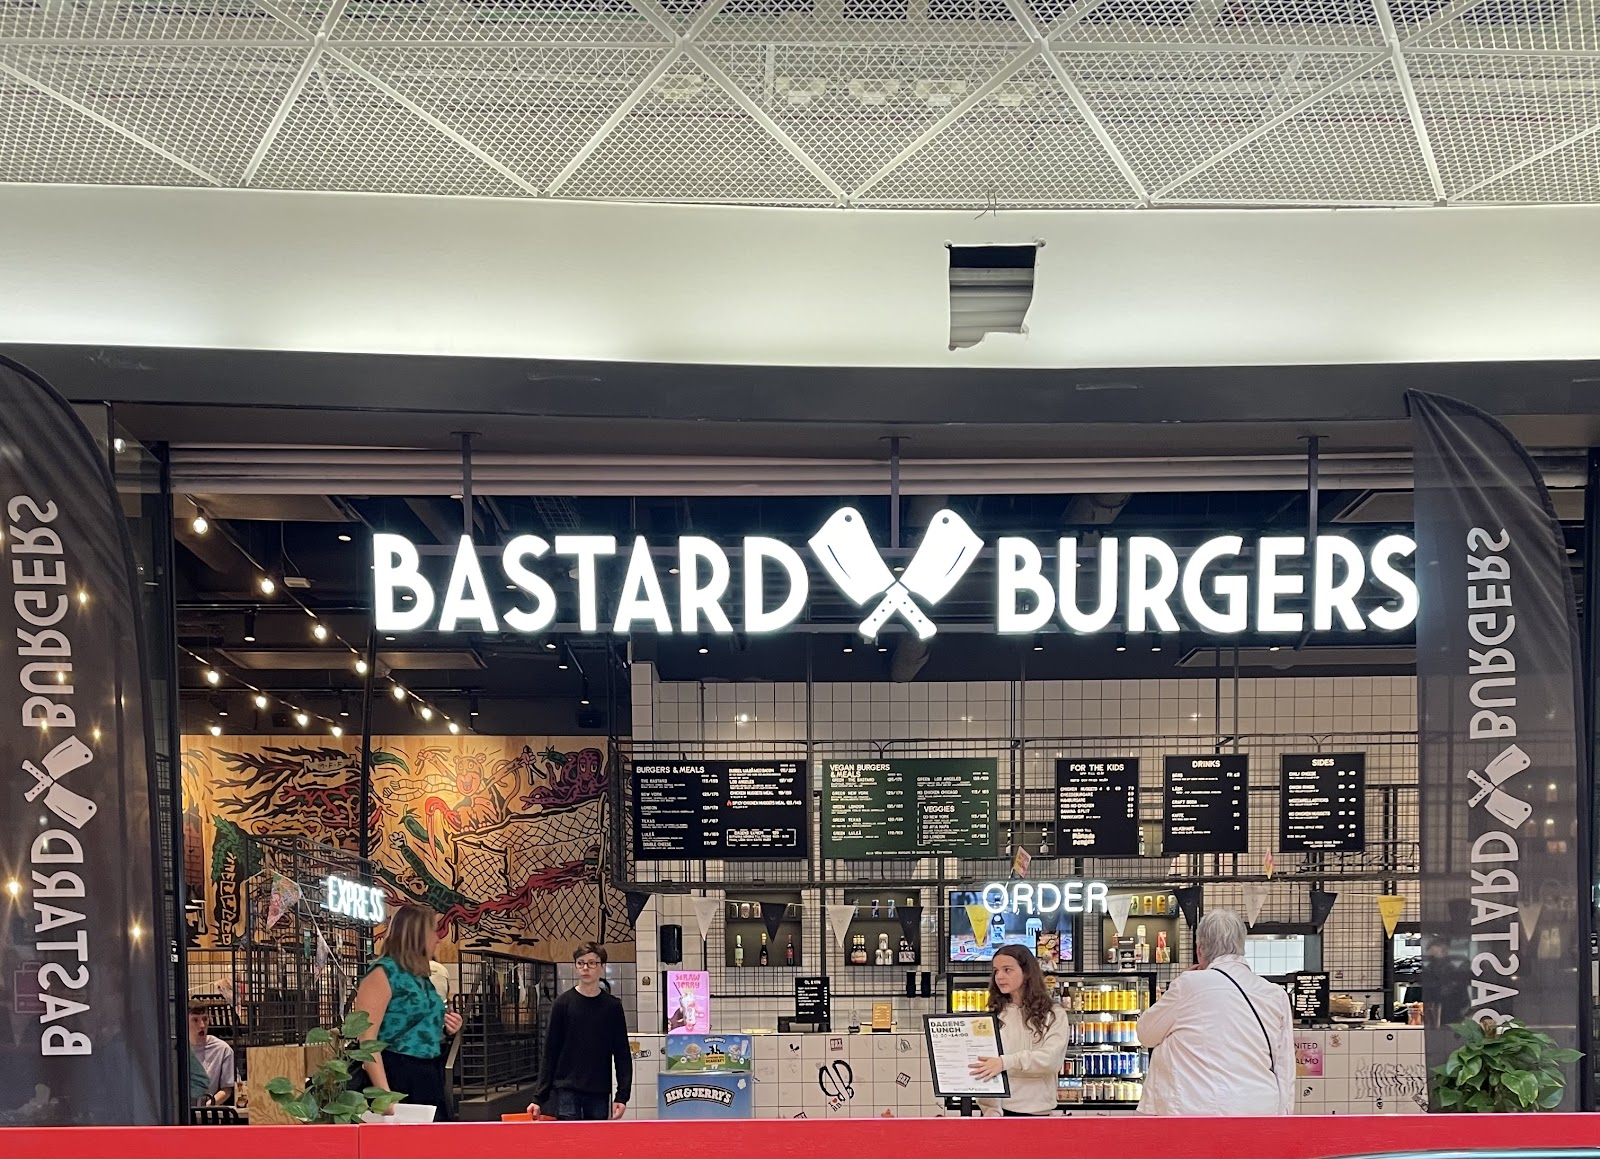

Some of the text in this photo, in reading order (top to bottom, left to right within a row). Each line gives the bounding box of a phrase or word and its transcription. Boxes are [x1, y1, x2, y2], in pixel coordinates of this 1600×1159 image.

[373, 533, 1419, 633] BASTARD BURGERS
[1191, 760, 1221, 768] DRINKS
[1311, 758, 1335, 767] SIDES
[636, 766, 671, 774] BURGERS
[679, 766, 705, 774] MEALS
[829, 763, 891, 771] VEGAN BURGERS
[1069, 763, 1125, 772] FOR THE KIDS
[836, 770, 862, 778] MEALS
[923, 805, 956, 813] VEGGIES
[327, 875, 385, 923] EXPRESS
[982, 882, 1108, 914] ORDER
[930, 1020, 966, 1028] DAGENS
[1294, 1042, 1318, 1050] NITED
